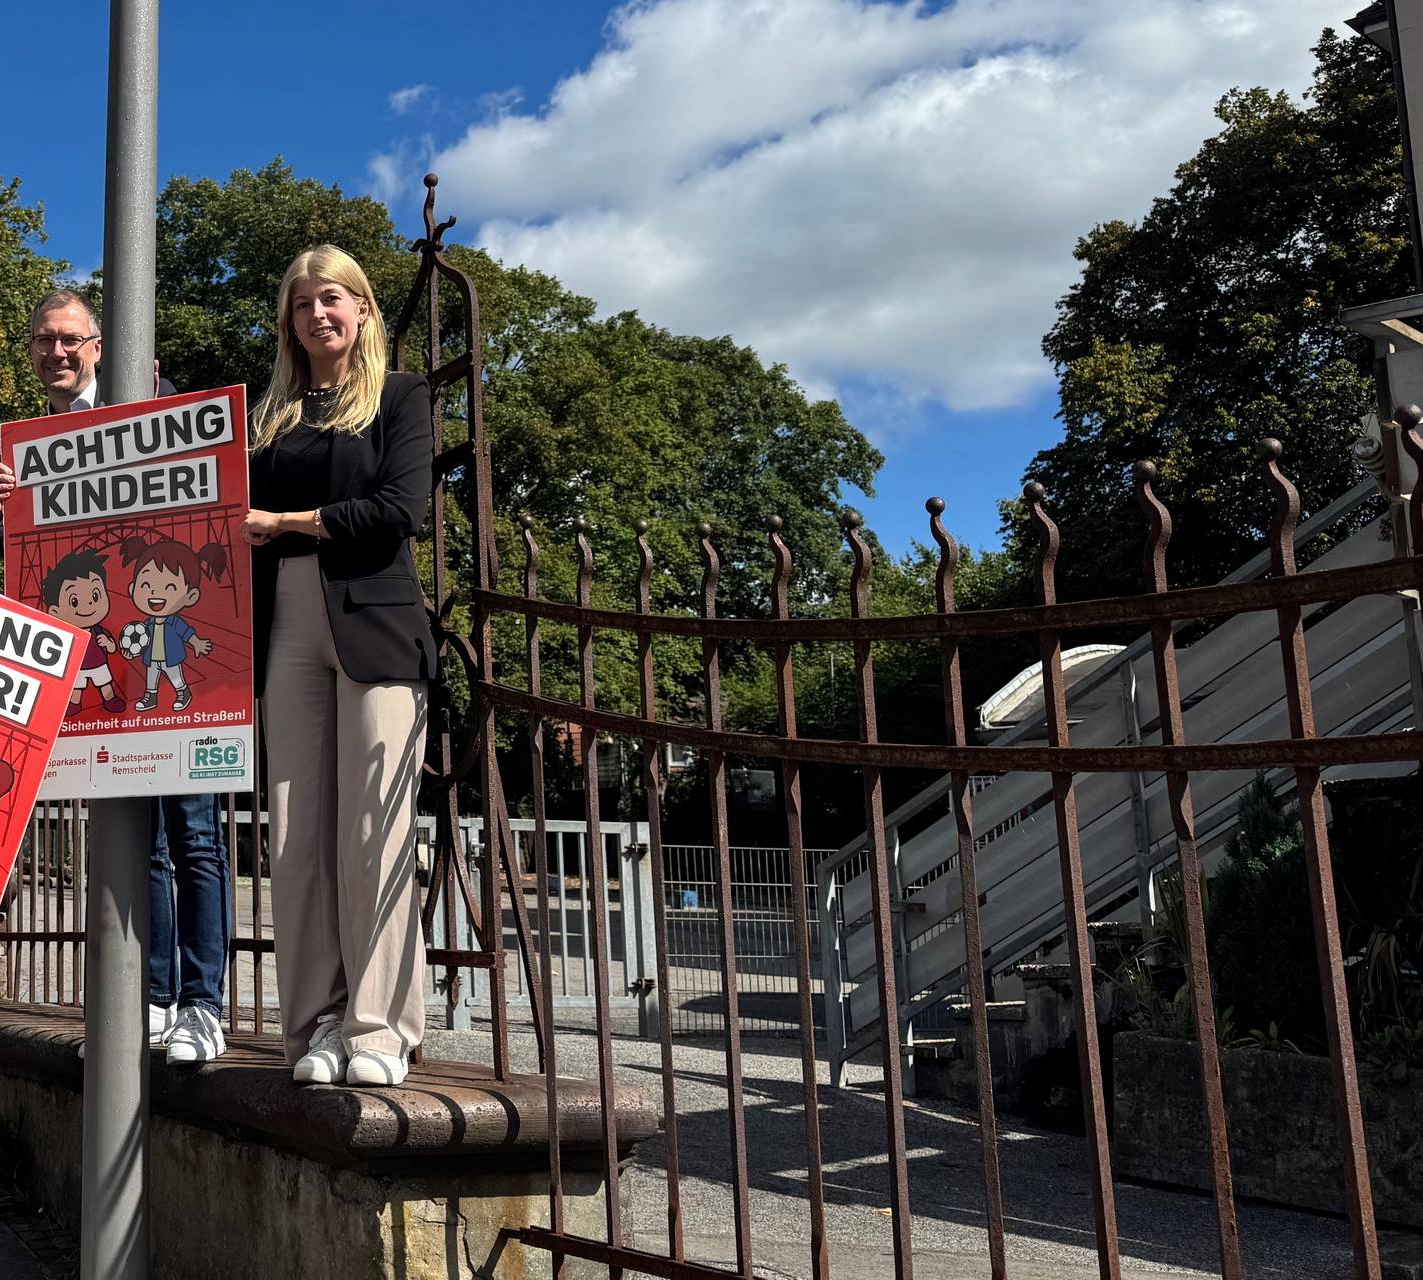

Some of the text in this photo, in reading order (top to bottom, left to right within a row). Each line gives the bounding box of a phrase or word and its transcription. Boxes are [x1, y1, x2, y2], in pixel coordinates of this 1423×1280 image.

[20, 404, 225, 481] ACHTUNG
[41, 462, 208, 519] KINDER!
[61, 709, 246, 732] Sicherheit auf unseren Straßen!
[195, 736, 218, 746] radio
[112, 751, 174, 764] Stadtsparkasse
[195, 746, 238, 767] RSG
[112, 764, 156, 775] Remscheid
